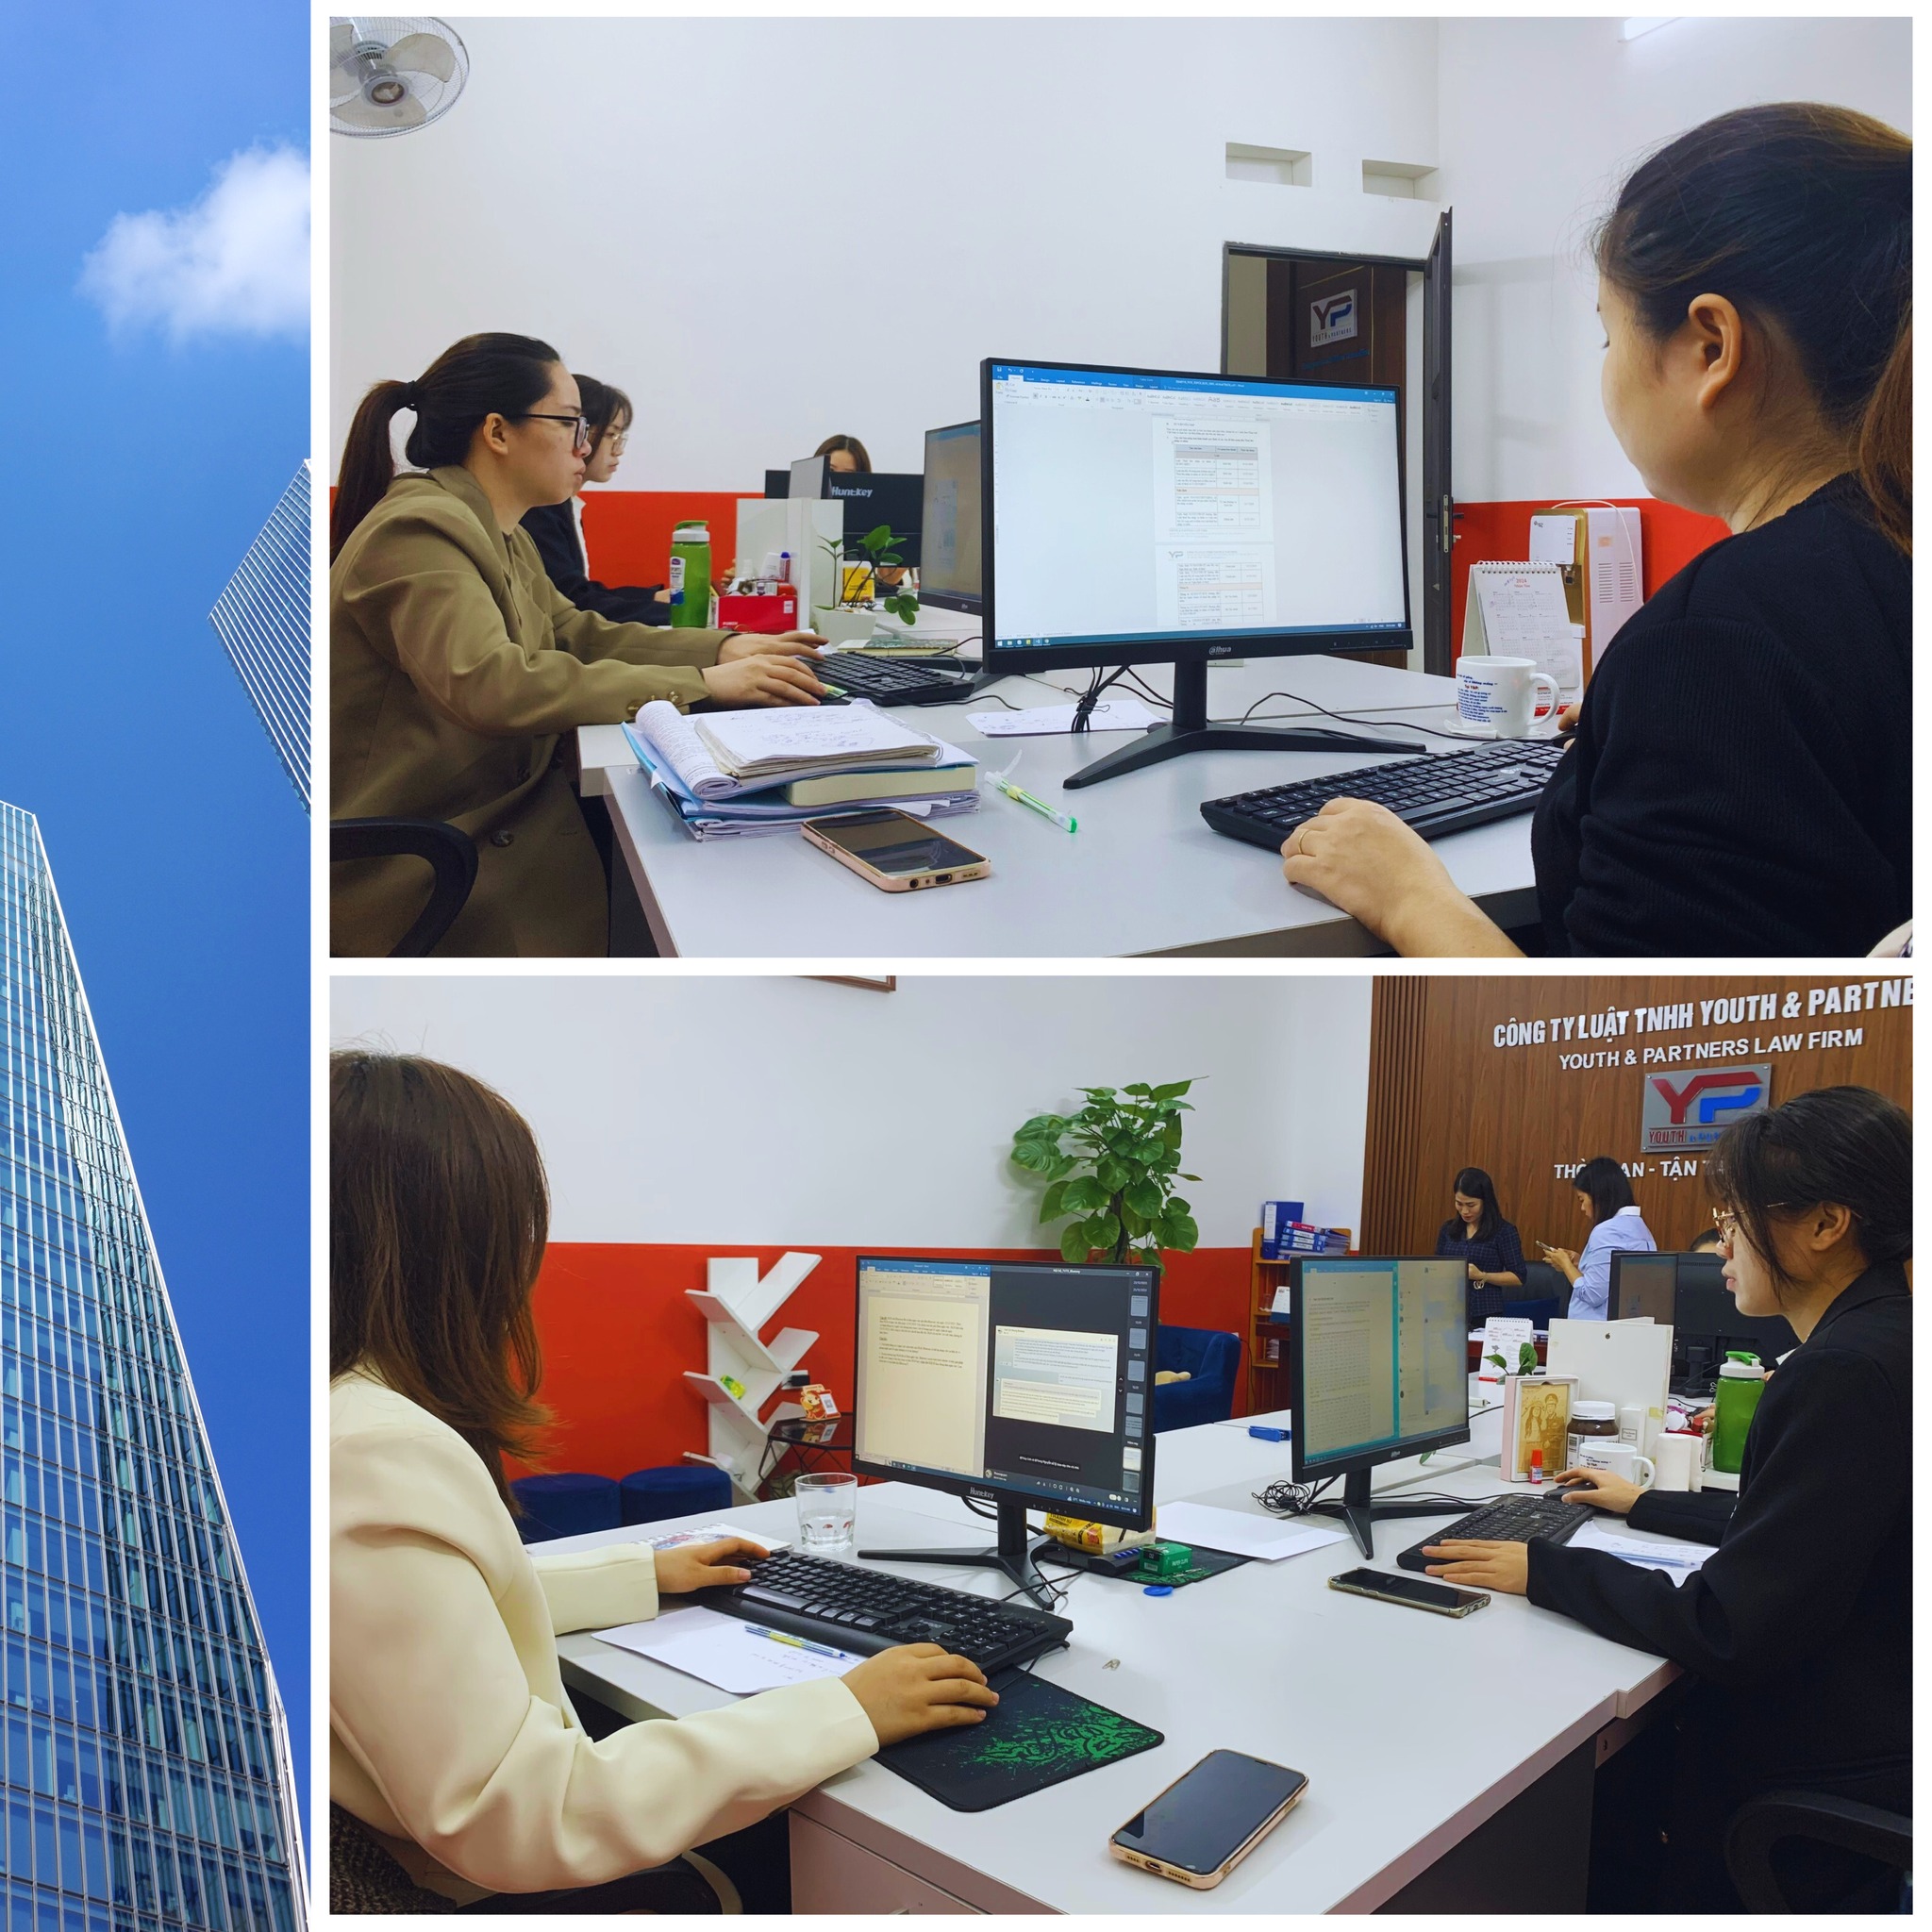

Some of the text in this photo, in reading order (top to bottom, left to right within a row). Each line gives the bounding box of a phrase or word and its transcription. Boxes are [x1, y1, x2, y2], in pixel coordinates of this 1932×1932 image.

[1493, 1018, 1546, 1048] CÔNG
[1550, 1017, 1575, 1041] TY
[1577, 1006, 1630, 1042] LUẬT
[1635, 1003, 1694, 1033] TNHH
[1700, 993, 1777, 1026] YOUTH
[1781, 991, 1802, 1019] &
[1558, 1028, 1863, 1070] YOUTH & PARTNERS LAW FIRM
[1649, 1130, 1686, 1143] YOUTH
[1660, 1156, 1697, 1181] TẬN
